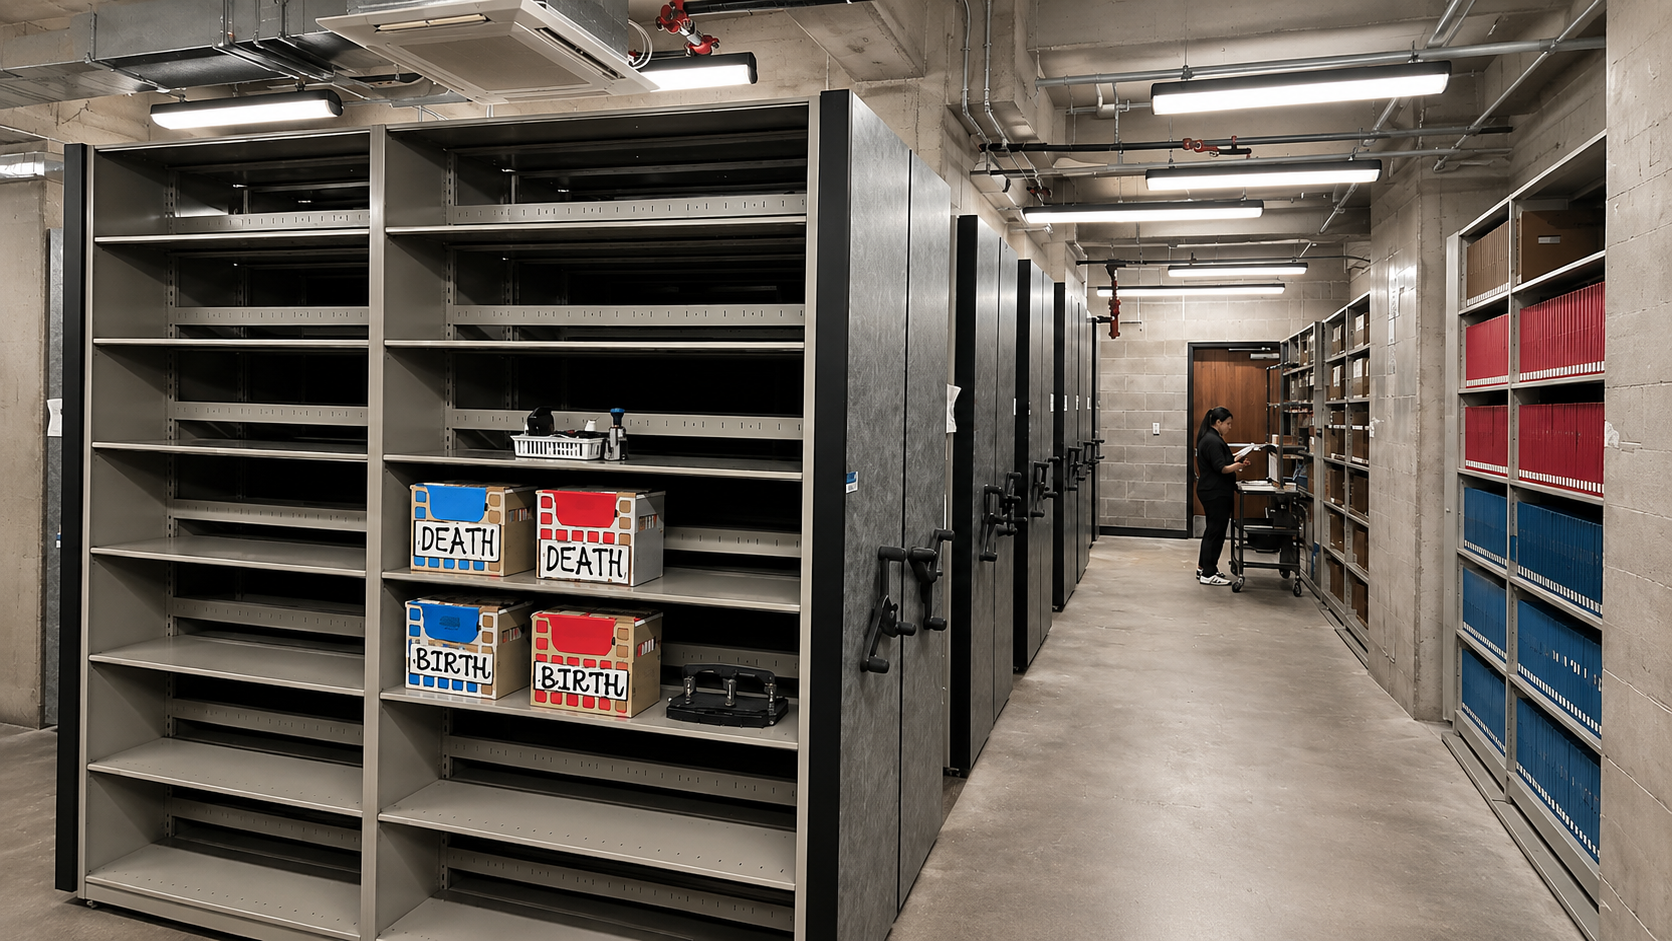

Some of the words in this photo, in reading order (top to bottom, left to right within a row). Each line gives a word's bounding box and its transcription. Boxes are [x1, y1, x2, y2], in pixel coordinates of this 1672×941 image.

[421, 526, 494, 557] DEATH
[546, 545, 623, 578] DEATH
[415, 647, 491, 679] BIRTH
[540, 665, 624, 697] BIRTH
